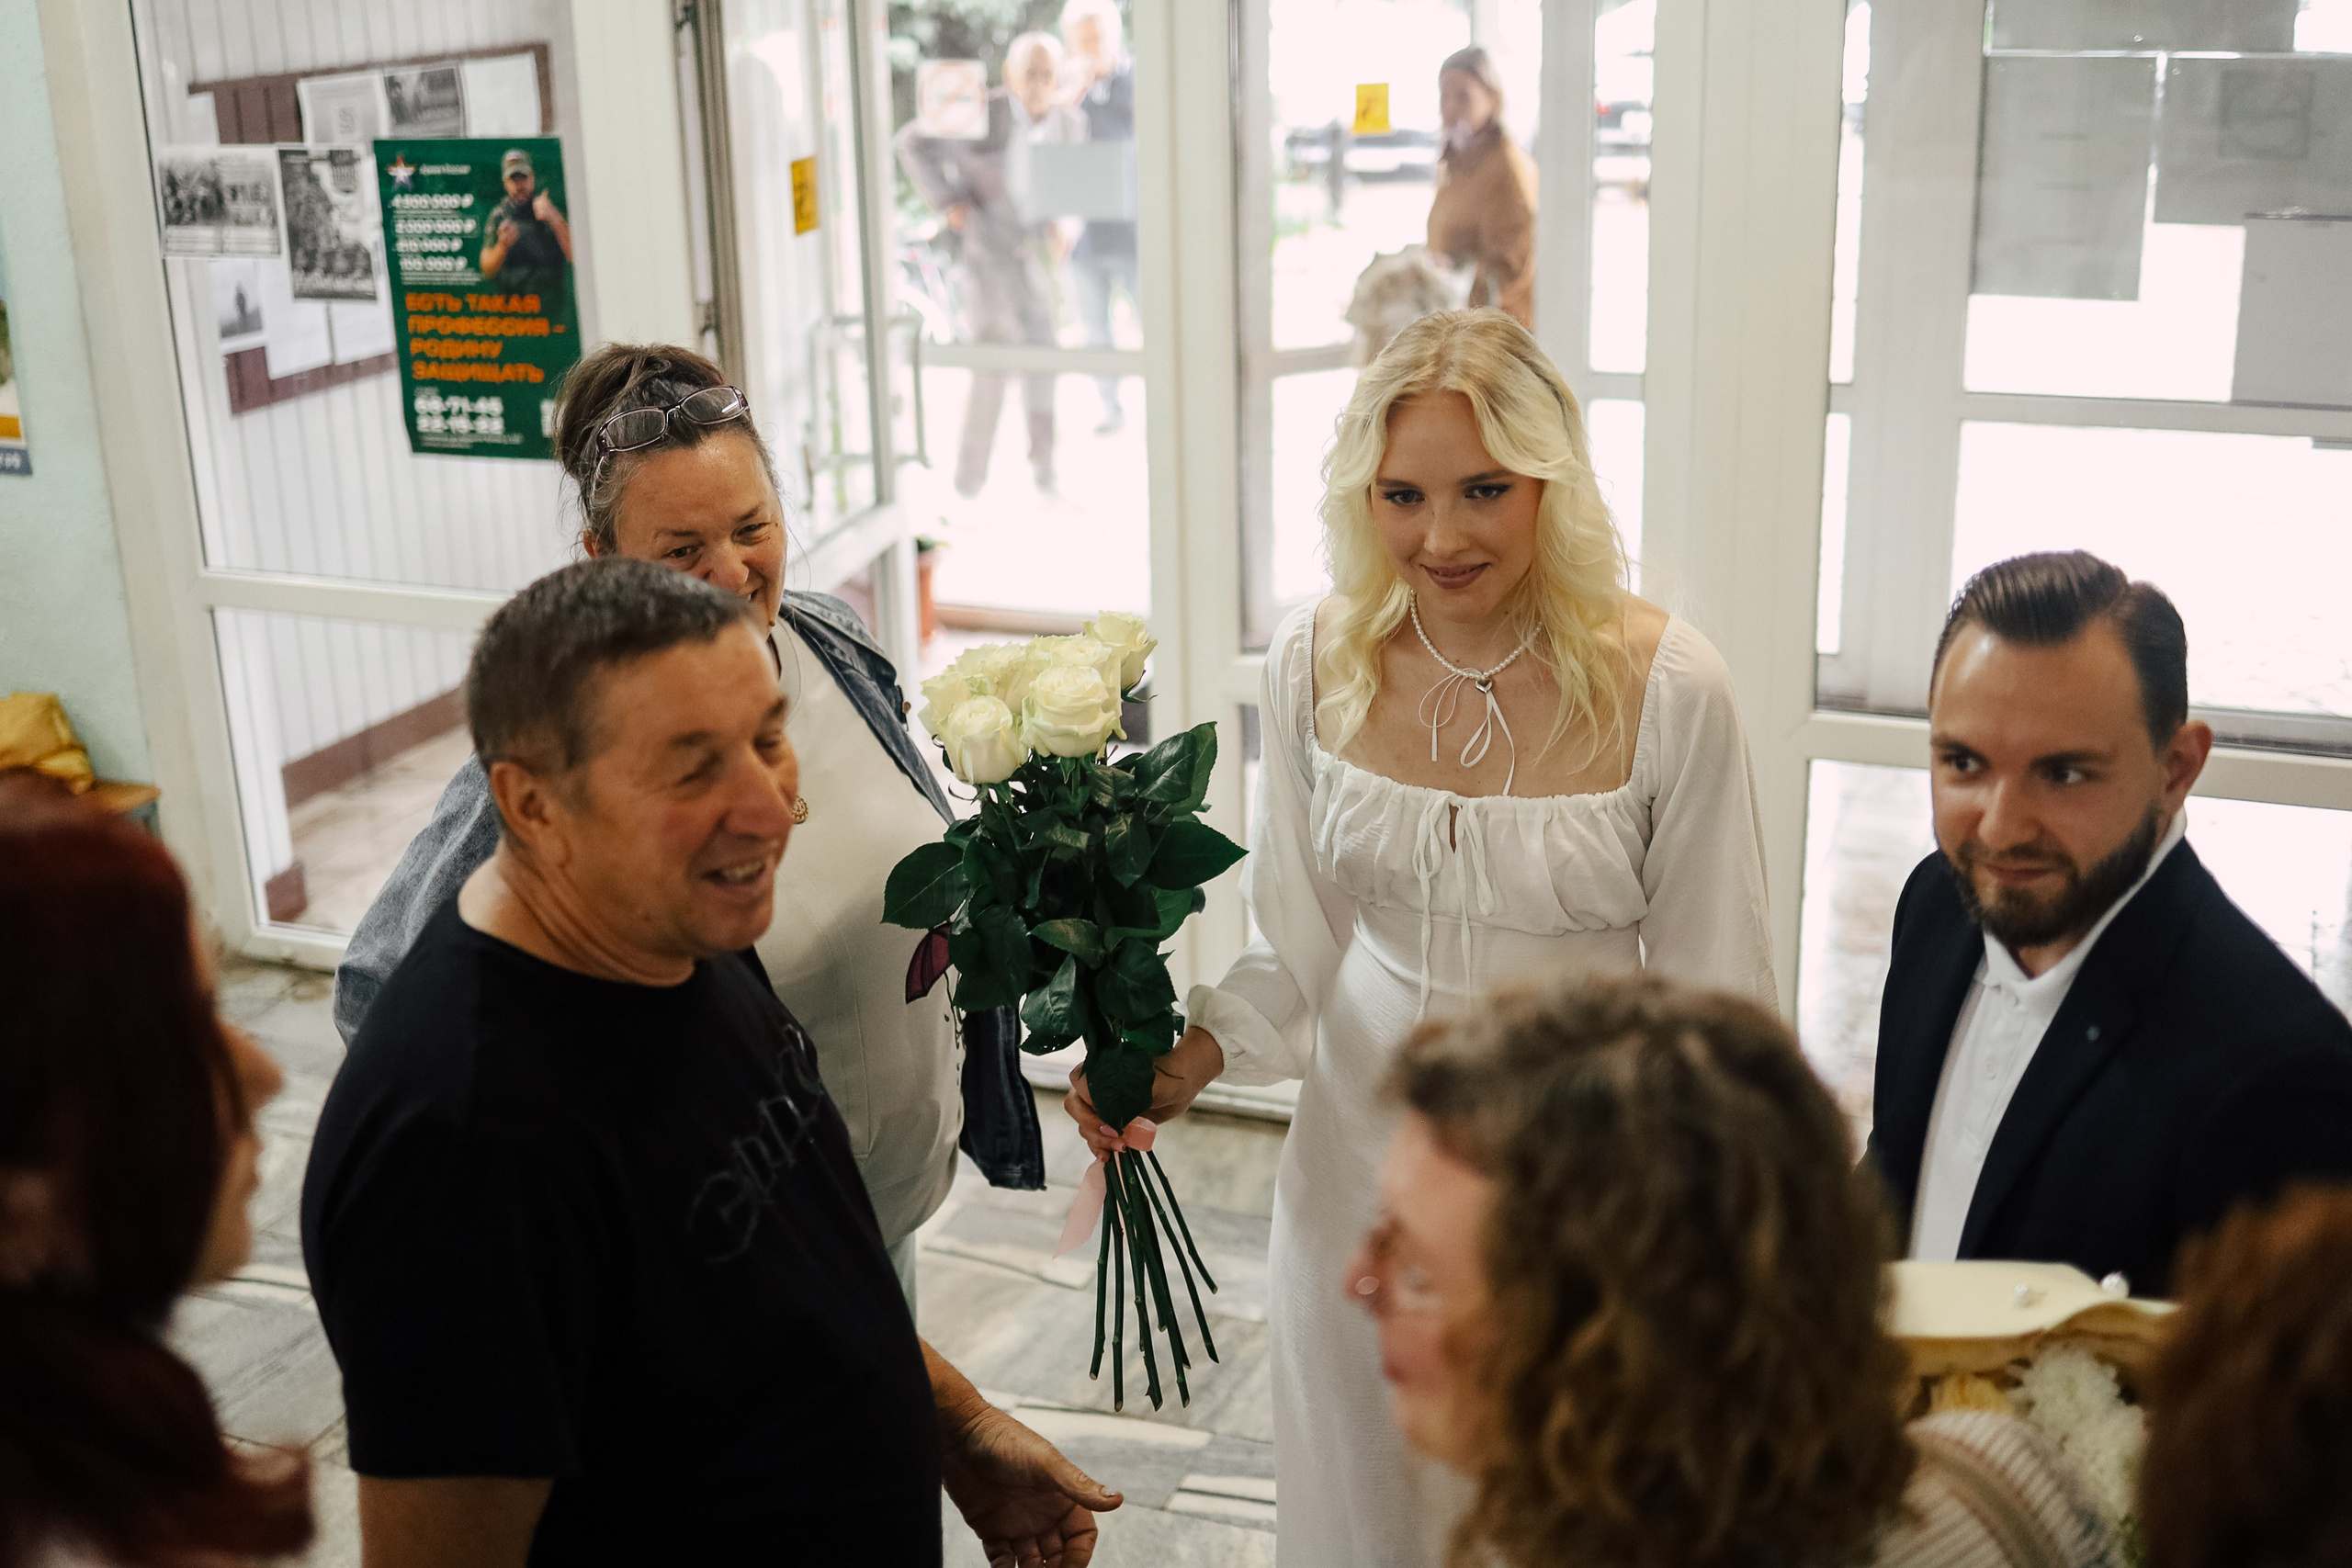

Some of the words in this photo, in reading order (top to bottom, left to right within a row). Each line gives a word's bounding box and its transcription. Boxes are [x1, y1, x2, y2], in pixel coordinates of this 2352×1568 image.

[406, 293, 462, 311] ЕСТЬ
[467, 295, 540, 312] ТАКАЯ
[409, 315, 549, 336] ПРОФЕССИЯ
[410, 338, 503, 358] РОДИНУ
[413, 361, 544, 383] ЗАЩИЩАТЬ
